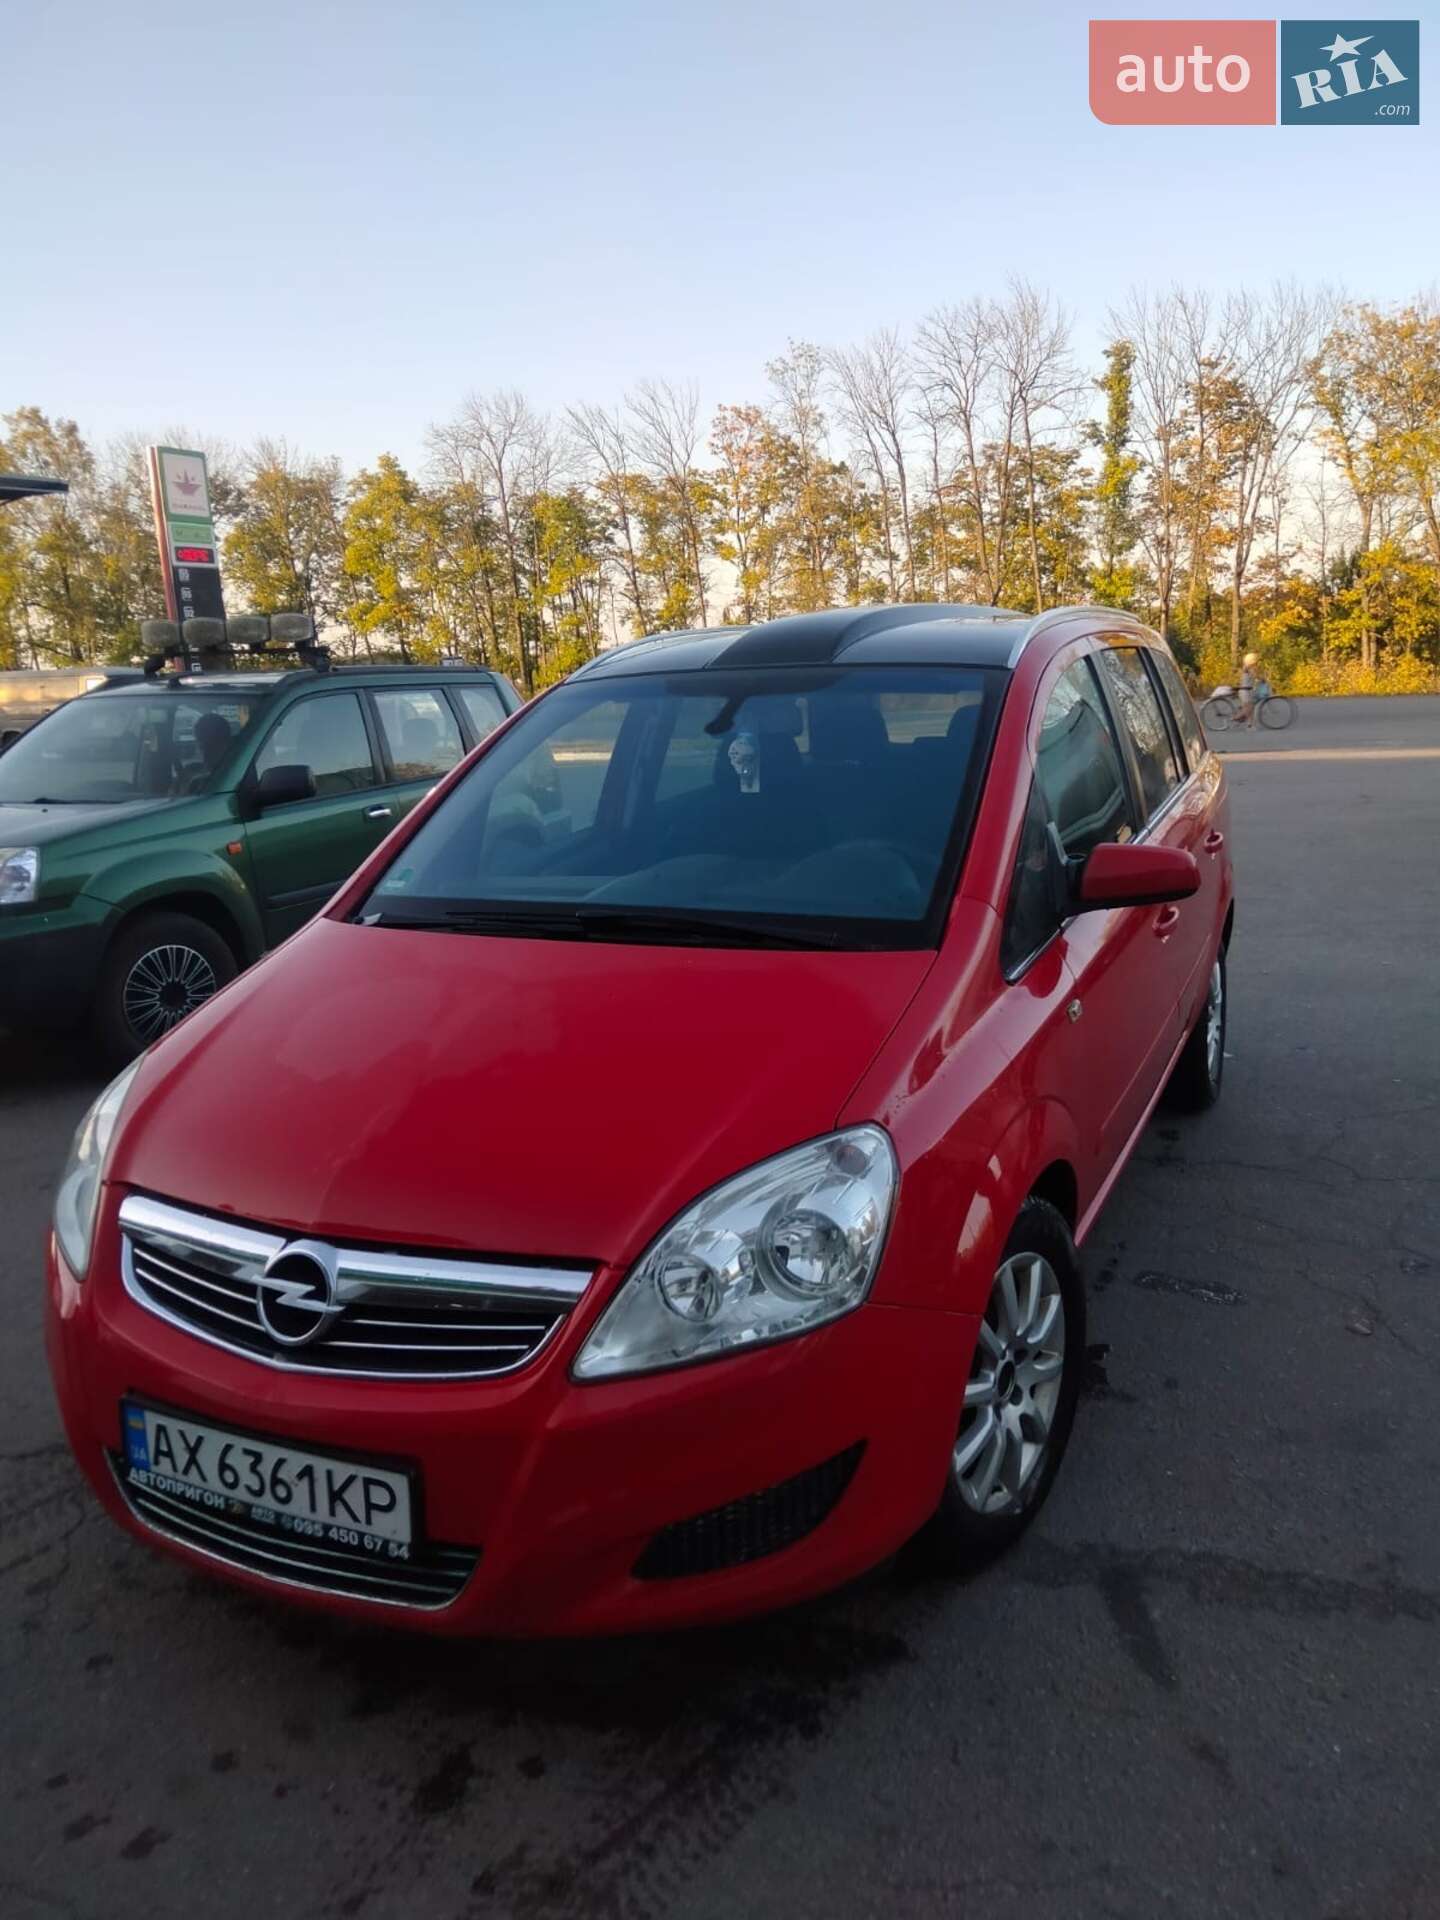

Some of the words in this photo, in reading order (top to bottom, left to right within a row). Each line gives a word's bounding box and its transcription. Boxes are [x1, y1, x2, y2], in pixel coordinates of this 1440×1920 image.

[129, 1466, 225, 1511] АВТОПРИГОН
[328, 1525, 359, 1547] 450
[363, 1533, 383, 1552] 67
[217, 1443, 317, 1513] 6361
[327, 1468, 397, 1526] KP
